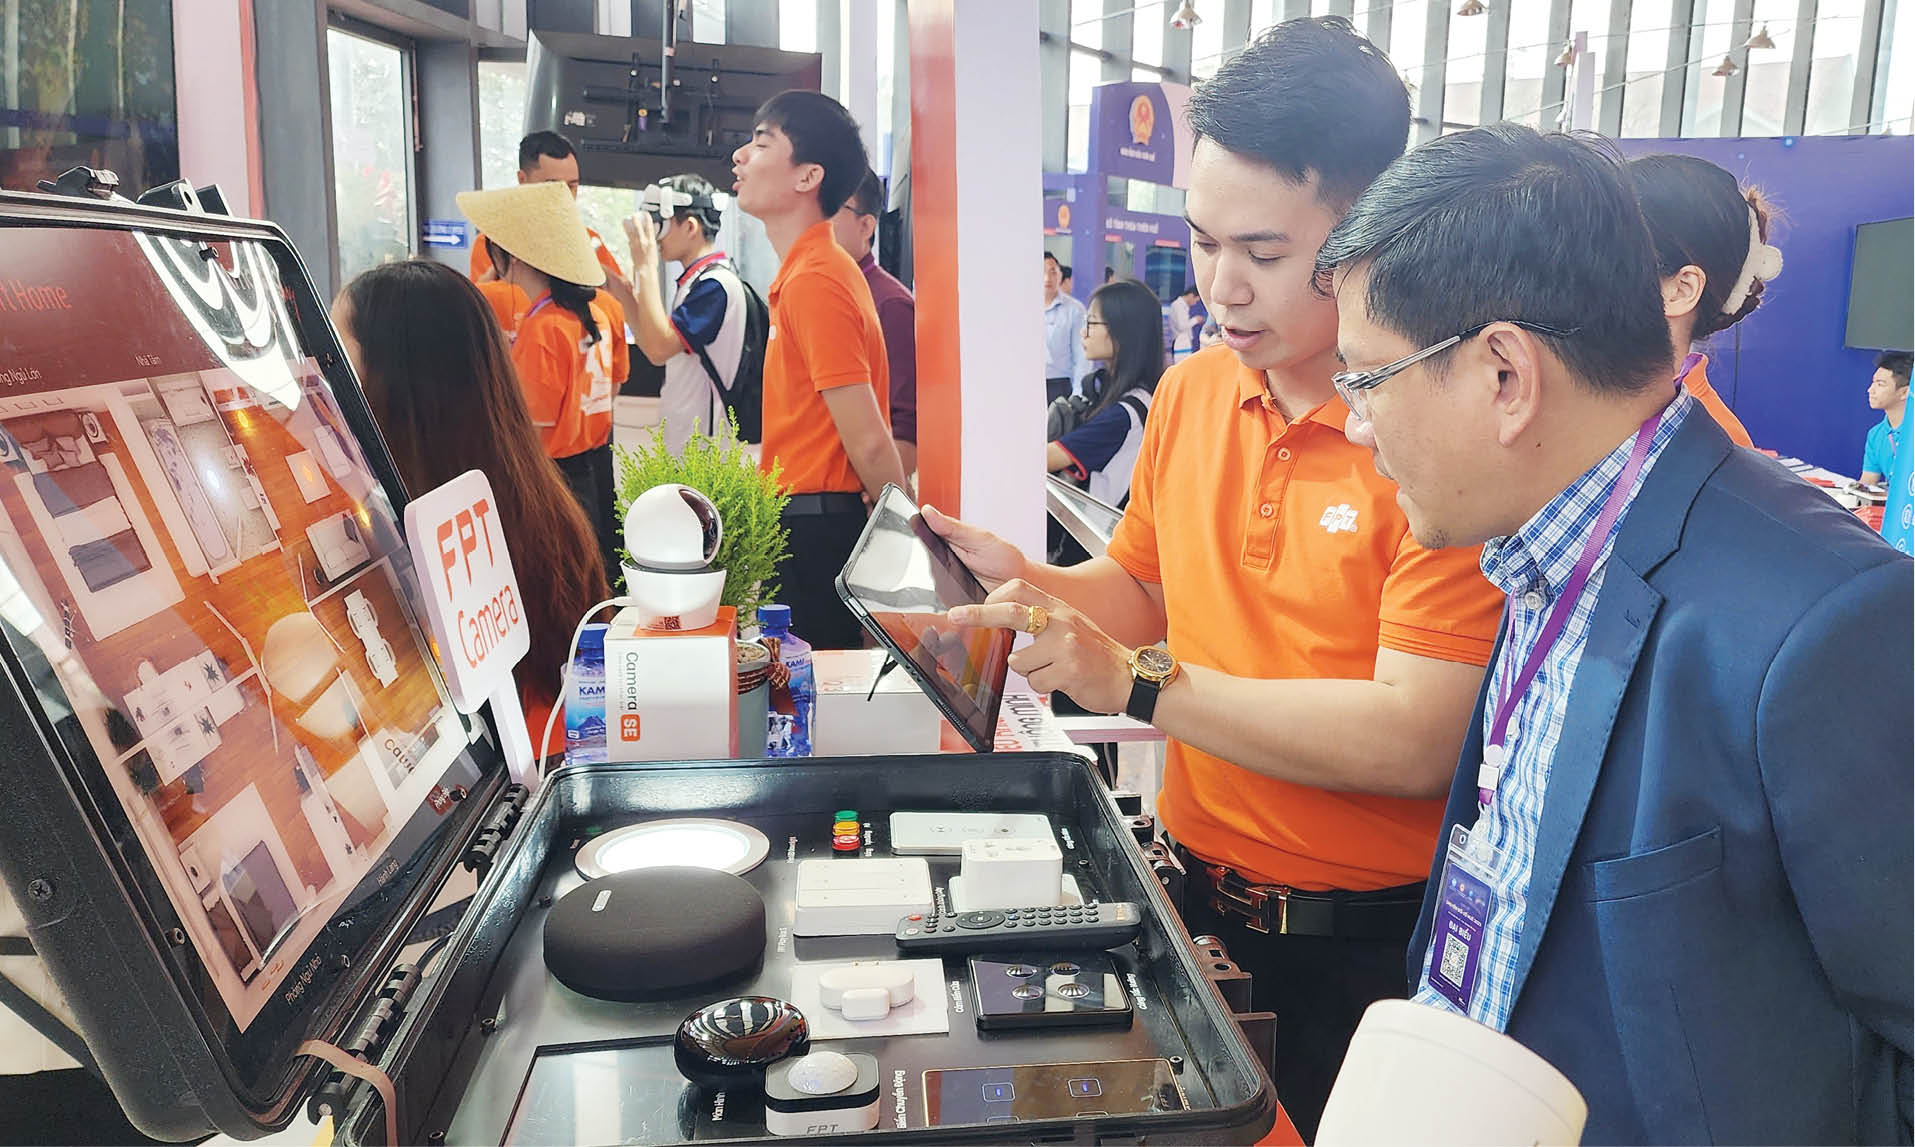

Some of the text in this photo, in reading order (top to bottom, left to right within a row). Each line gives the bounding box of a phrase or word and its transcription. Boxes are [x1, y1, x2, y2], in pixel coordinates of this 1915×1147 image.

[8, 280, 72, 311] Home
[436, 498, 494, 602] FPT
[457, 584, 519, 669] Camera
[623, 651, 639, 737] Camera SE
[806, 1124, 840, 1134] FPT
